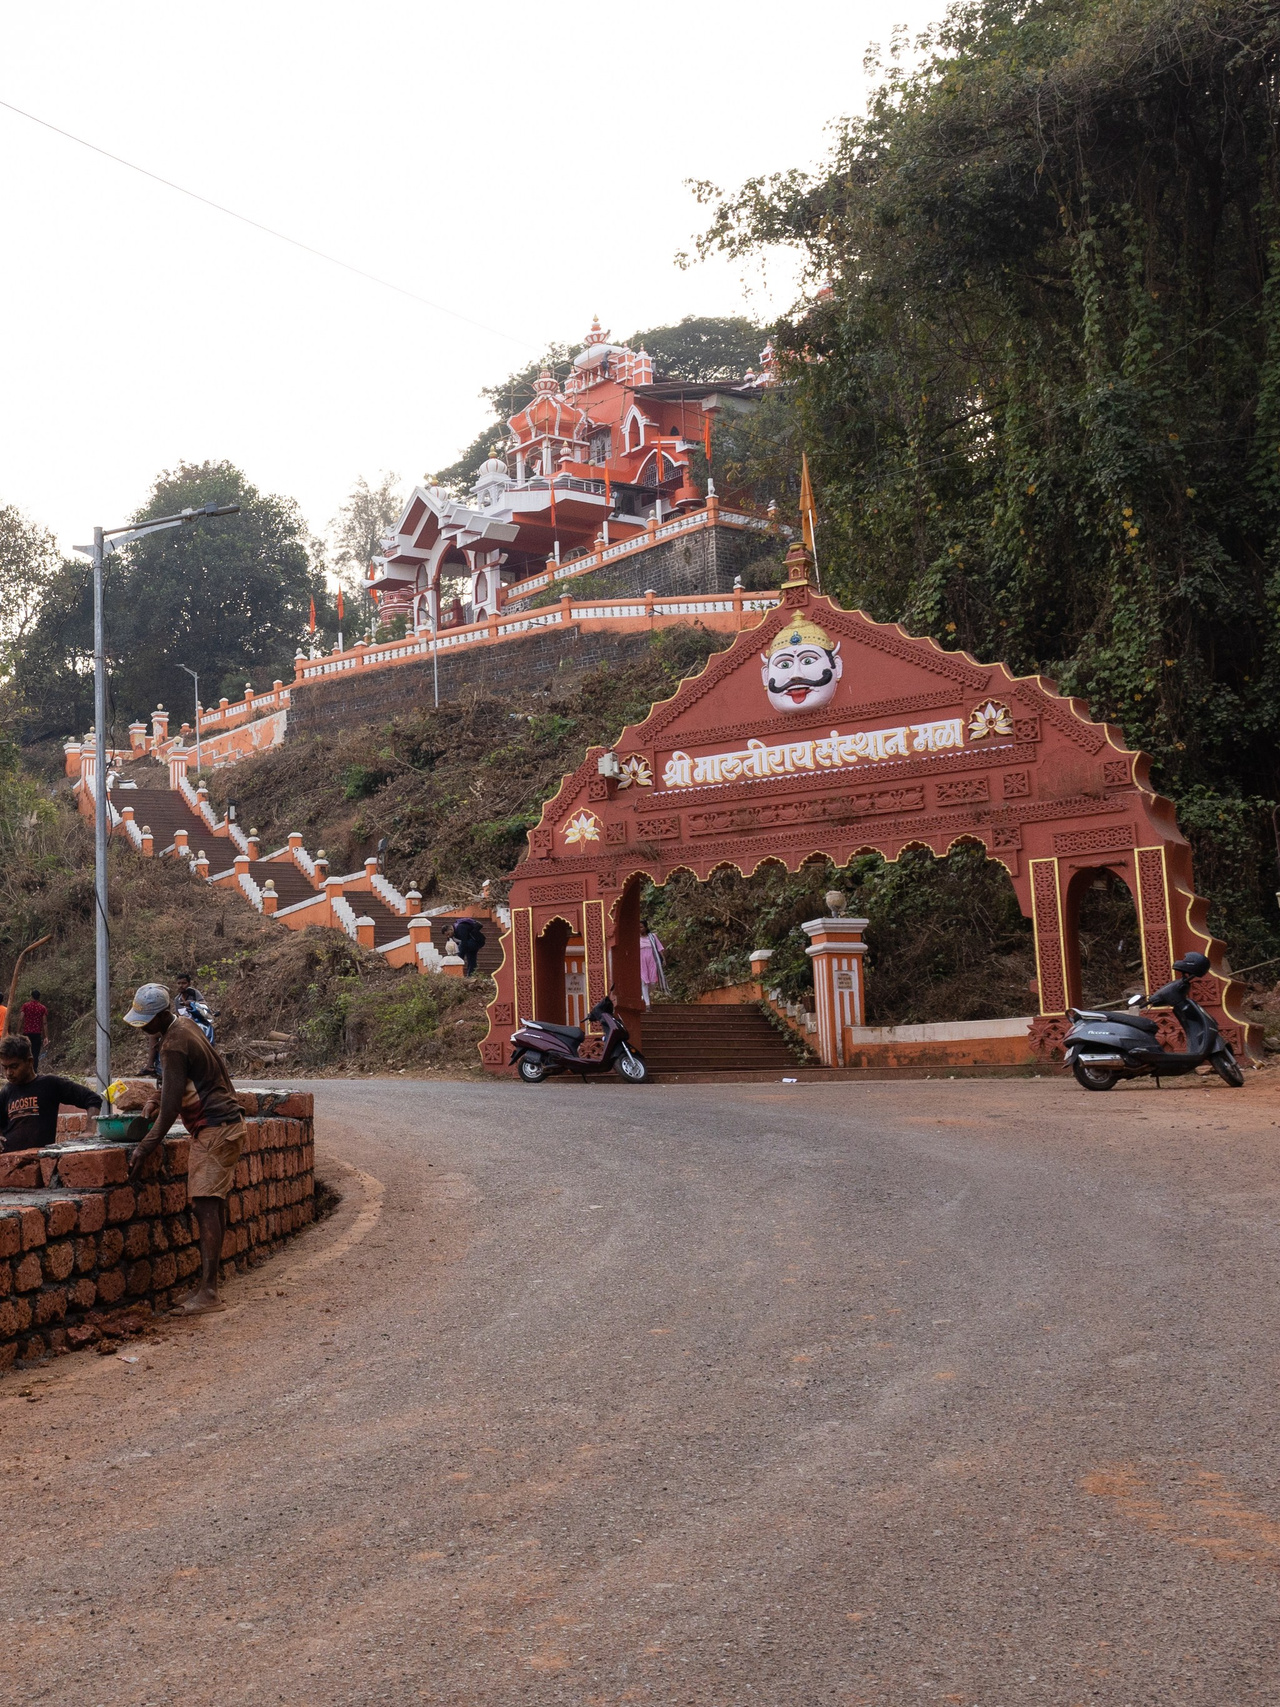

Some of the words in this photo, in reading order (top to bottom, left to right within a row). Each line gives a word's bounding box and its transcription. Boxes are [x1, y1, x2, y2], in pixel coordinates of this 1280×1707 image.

[662, 751, 693, 787] श्री
[815, 730, 910, 766] संस्थान
[909, 718, 965, 752] मळा
[8, 1096, 38, 1112] LACOSTE
